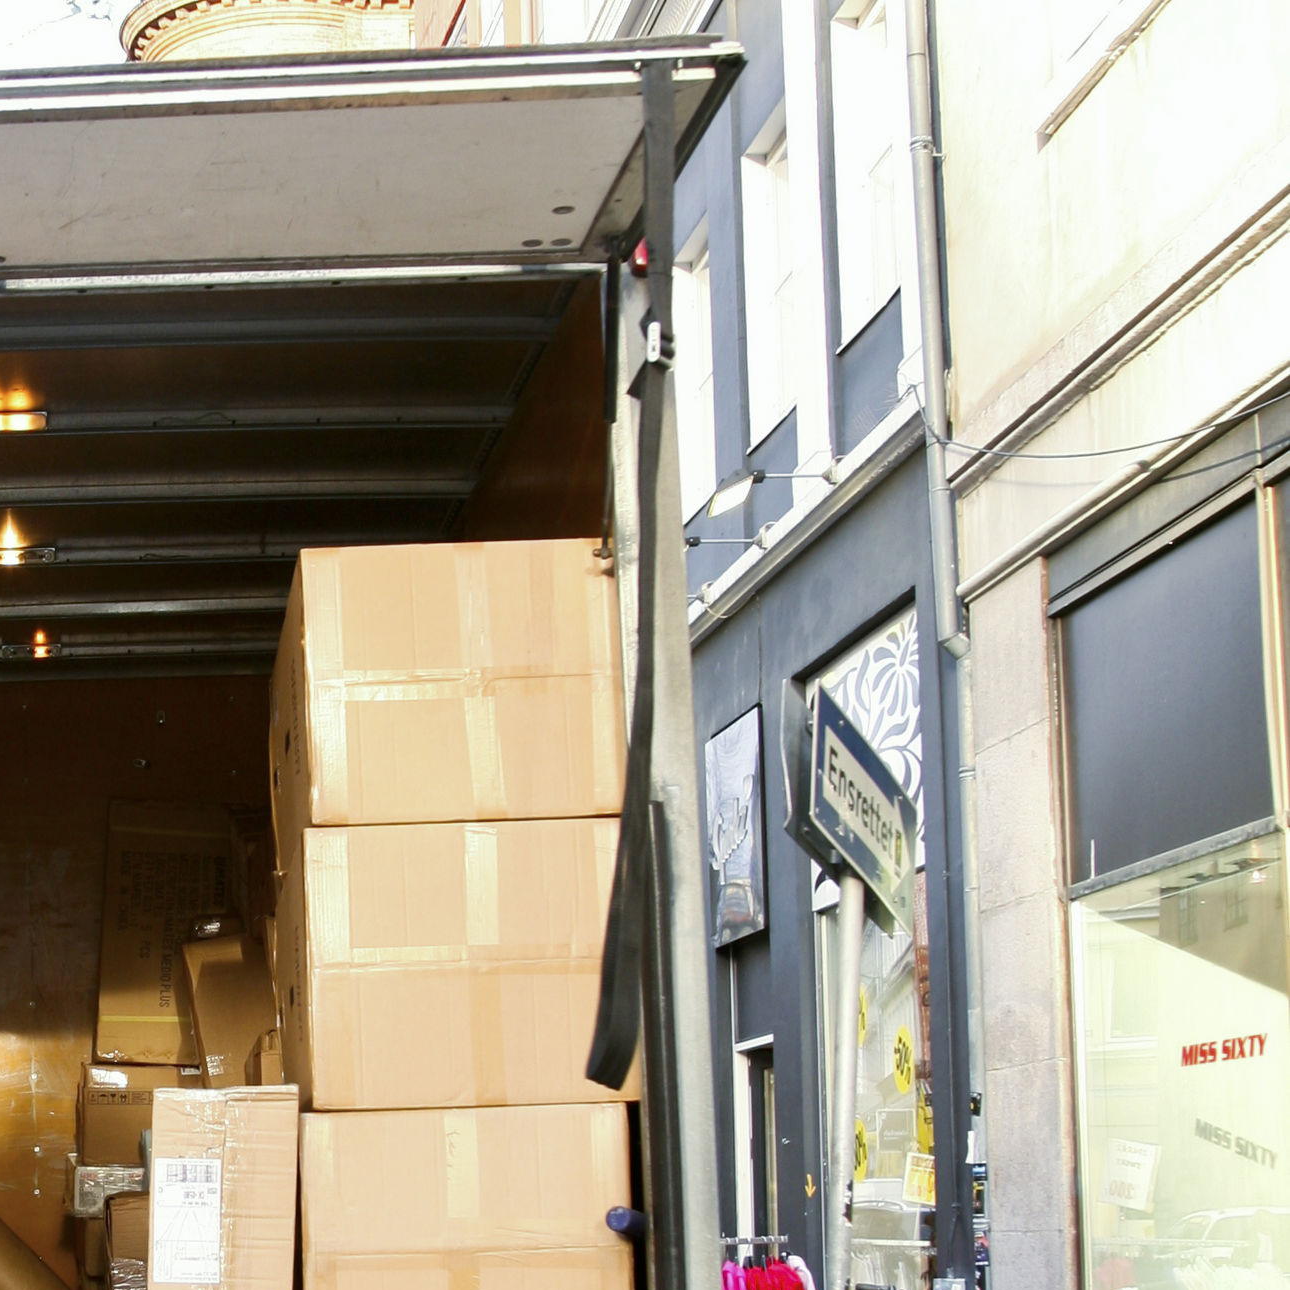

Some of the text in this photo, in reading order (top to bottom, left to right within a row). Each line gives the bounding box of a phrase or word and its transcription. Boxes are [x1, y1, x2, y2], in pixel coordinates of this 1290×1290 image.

[828, 745, 894, 861] Ensrettet
[158, 983, 170, 1008] PLUS
[1181, 1033, 1267, 1067] MISS SIXTY
